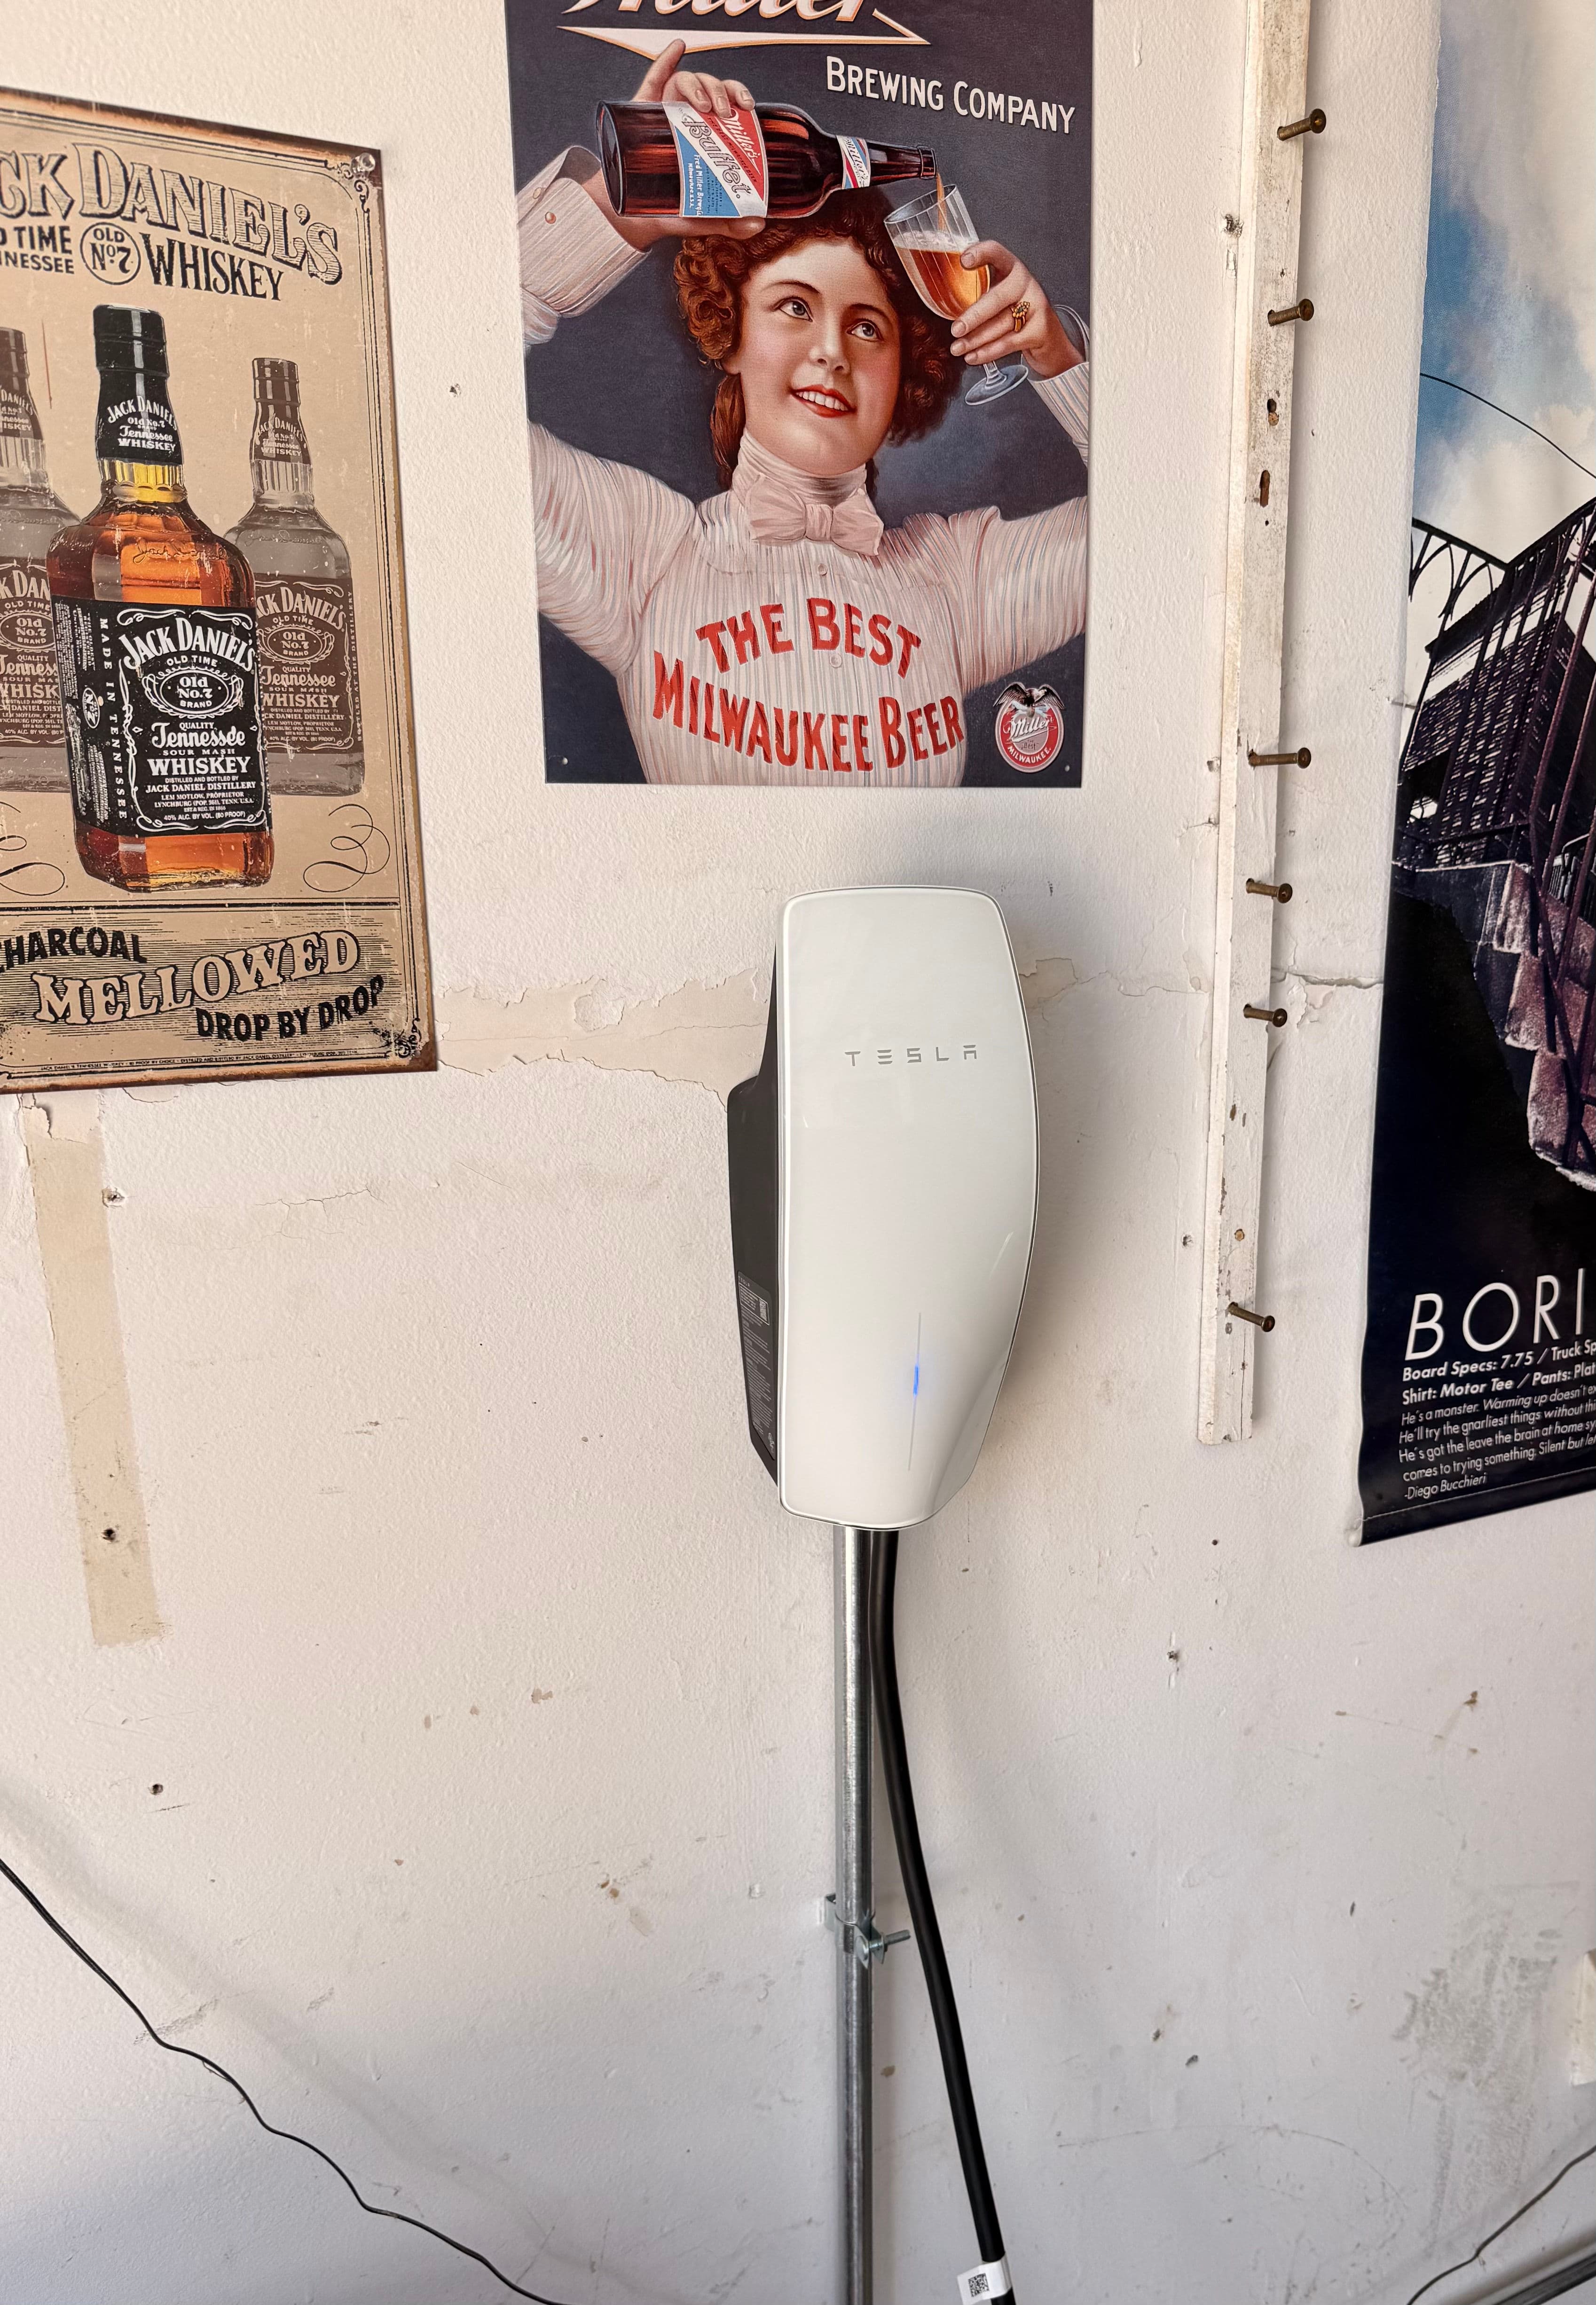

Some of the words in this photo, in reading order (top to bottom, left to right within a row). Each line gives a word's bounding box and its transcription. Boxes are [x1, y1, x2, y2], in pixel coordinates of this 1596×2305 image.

[826, 55, 943, 110] BREWING
[953, 81, 1075, 134] COMPANY
[72, 142, 342, 285] DANIEL'S
[14, 225, 72, 255] TIME
[94, 228, 125, 243] OLD
[140, 232, 283, 301] WHISKEY
[107, 399, 136, 423] JACK
[127, 417, 145, 425] Old
[118, 438, 176, 451] WHISKEY
[119, 425, 173, 442] Tennessee
[5, 600, 24, 609] OLD
[27, 601, 51, 611] TIME
[280, 586, 346, 630] DANIEL'S
[15, 627, 47, 637] No.7
[16, 618, 43, 628] Old
[272, 615, 290, 623] OLD
[292, 615, 314, 625] TIME
[99, 617, 113, 670] MADE
[118, 626, 178, 669] JACK
[175, 617, 256, 672] DANIEL'S
[281, 640, 309, 649] No.7
[283, 631, 306, 641] Old
[695, 603, 794, 674] THE
[807, 598, 922, 679] BEST
[166, 655, 188, 667] OLD
[191, 655, 218, 667] TIME
[179, 677, 209, 688] Old
[260, 665, 336, 687] Tennessee
[105, 682, 116, 702] IN
[178, 688, 213, 699] No.7
[180, 700, 212, 708] BRAND
[653, 650, 873, 772] MILWAUKEE
[878, 696, 965, 769] BEER
[151, 723, 246, 748] Tennessee
[179, 722, 214, 731] QUALITY
[147, 756, 251, 776] WHISKEY
[145, 785, 170, 793] JACK
[172, 783, 206, 792] DANIEL
[207, 781, 256, 790] DISTILLERY
[0, 927, 148, 973] HARCOAL
[31, 929, 360, 1025] MELLOWED
[196, 1007, 271, 1042] DROP
[277, 1005, 311, 1038] BY
[318, 974, 385, 1031] DROP
[844, 1044, 978, 1067] TESLA
[1405, 1268, 1586, 1361] BORI
[1402, 1361, 1449, 1382] Board
[1450, 1361, 1498, 1377] Specs:
[1500, 1351, 1535, 1369] 7.75
[1551, 1340, 1583, 1361] Truck
[1402, 1387, 1437, 1405] Shirt:
[1439, 1383, 1488, 1398] Motor
[1491, 1377, 1515, 1392] Tee
[1532, 1369, 1572, 1386] Pants:
[1401, 1410, 1424, 1426] He's
[1425, 1411, 1433, 1421] a
[1434, 1402, 1479, 1419] monster.
[1483, 1394, 1532, 1410] Warming
[1533, 1394, 1548, 1407] up
[1549, 1384, 1587, 1402] doesn't
[1399, 1425, 1424, 1444] He'll
[1425, 1427, 1441, 1442] try
[1443, 1420, 1460, 1436] the
[1461, 1414, 1508, 1436] gnarliest
[1510, 1410, 1542, 1425] things
[1544, 1404, 1584, 1418] without
[1399, 1447, 1424, 1463] He's
[1426, 1444, 1445, 1462] got
[1447, 1439, 1464, 1454] the
[1465, 1436, 1493, 1451] leave
[1495, 1430, 1512, 1445] the
[1514, 1426, 1540, 1442] brain
[1541, 1424, 1553, 1437] at
[1554, 1421, 1583, 1434] home
[1403, 1467, 1439, 1482] comes
[1440, 1463, 1451, 1474] to
[1453, 1457, 1482, 1475] trying
[1484, 1446, 1536, 1466] something.
[1538, 1439, 1566, 1455] Silent
[1567, 1436, 1584, 1450] but
[1404, 1485, 1439, 1500] -Diego
[1440, 1472, 1487, 1493] Bucchieri
